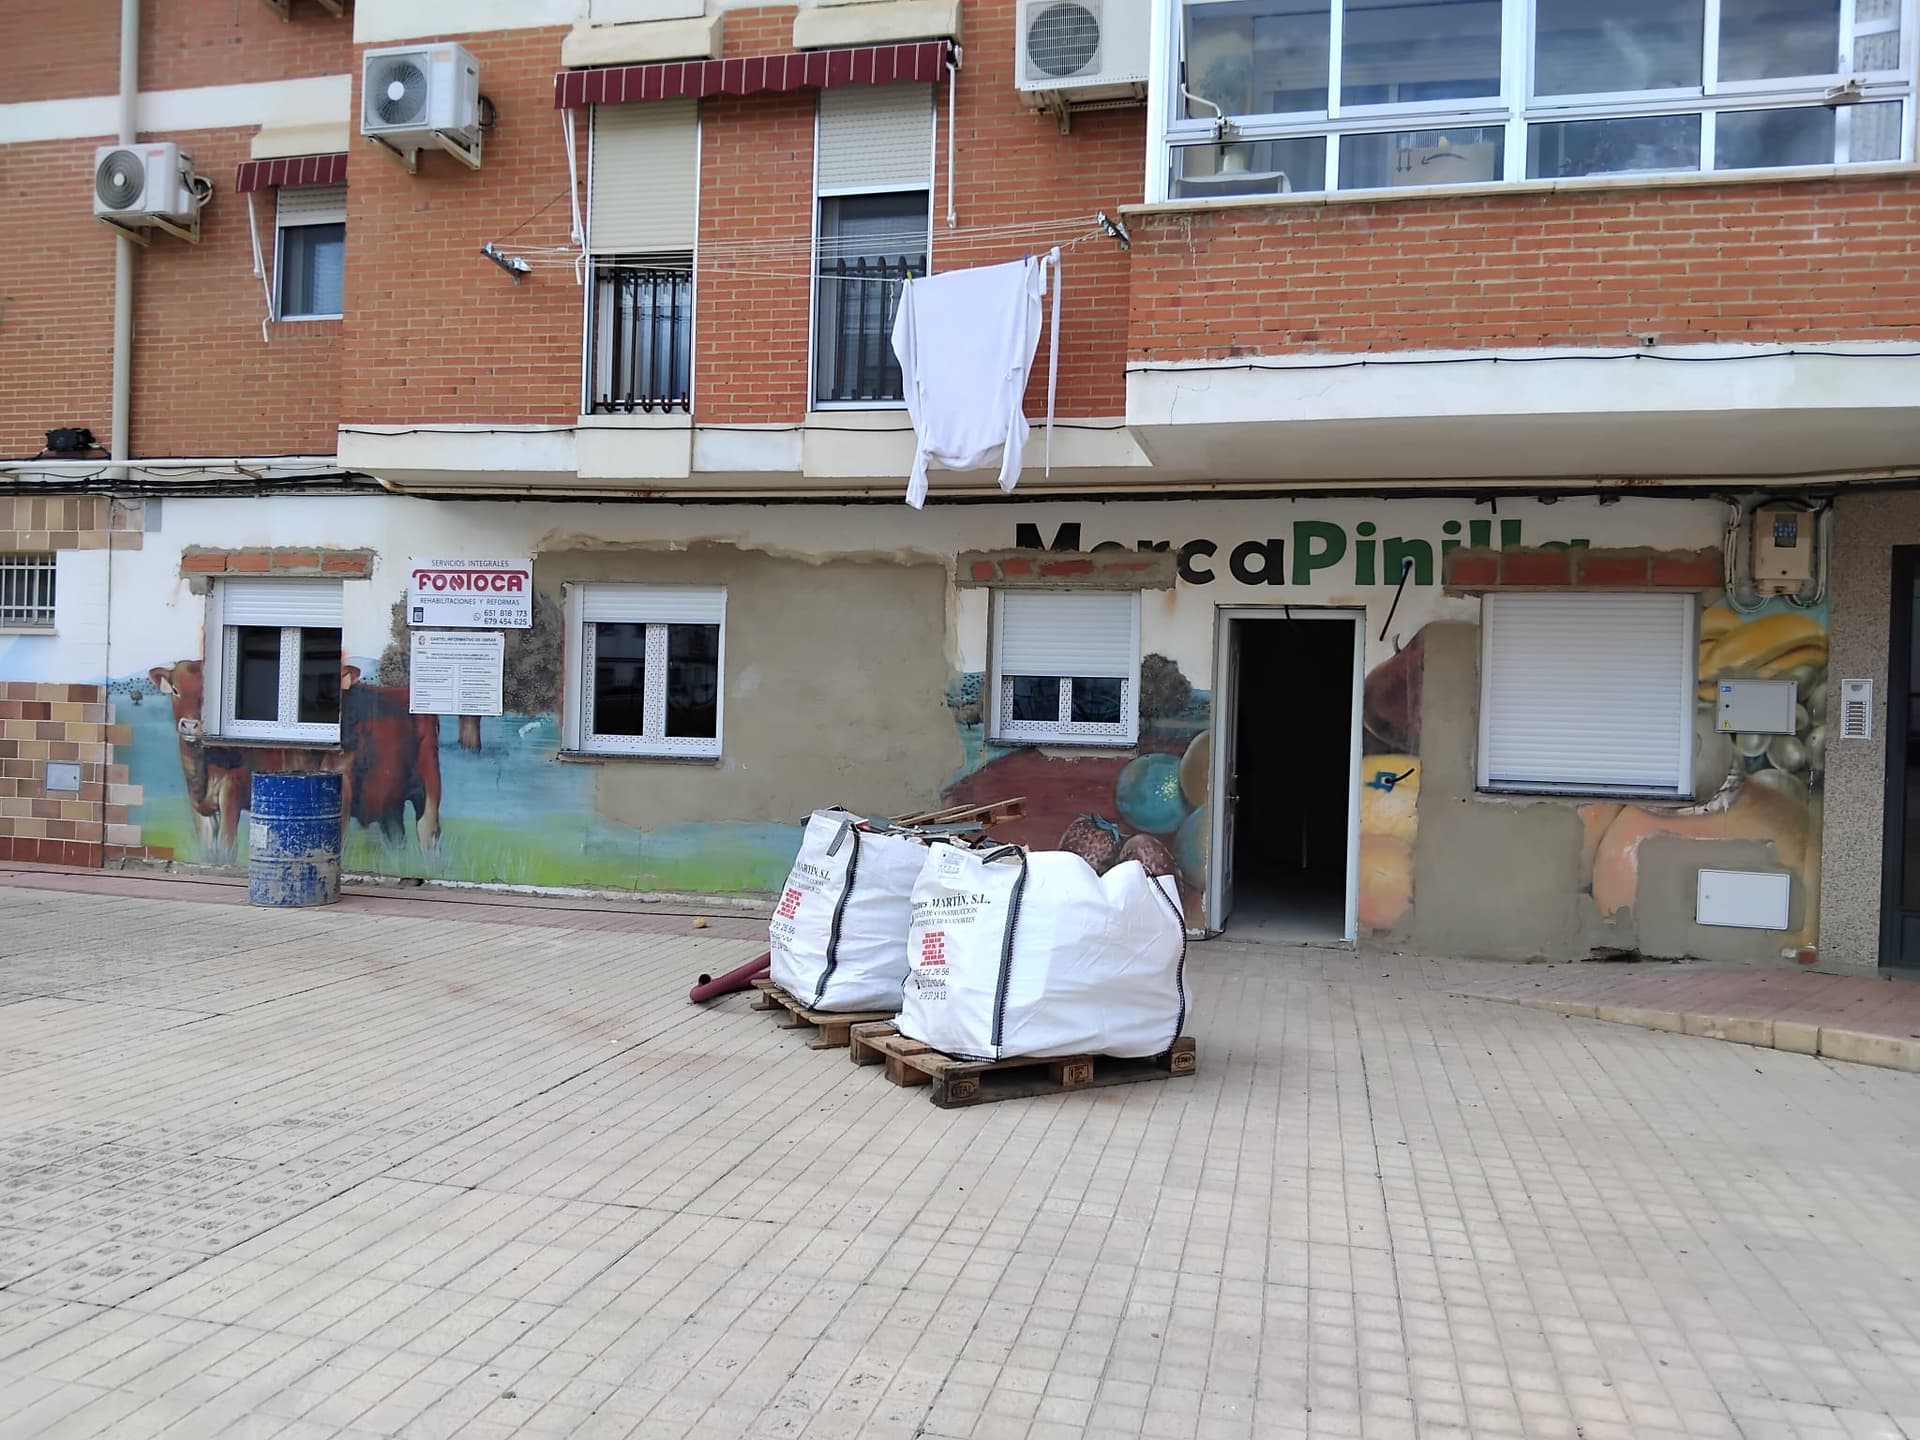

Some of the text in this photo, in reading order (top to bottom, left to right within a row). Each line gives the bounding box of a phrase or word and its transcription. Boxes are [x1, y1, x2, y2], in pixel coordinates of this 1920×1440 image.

[1015, 519, 1590, 586] caPini
[516, 610, 528, 618] 173
[971, 893, 991, 905] S.L.
